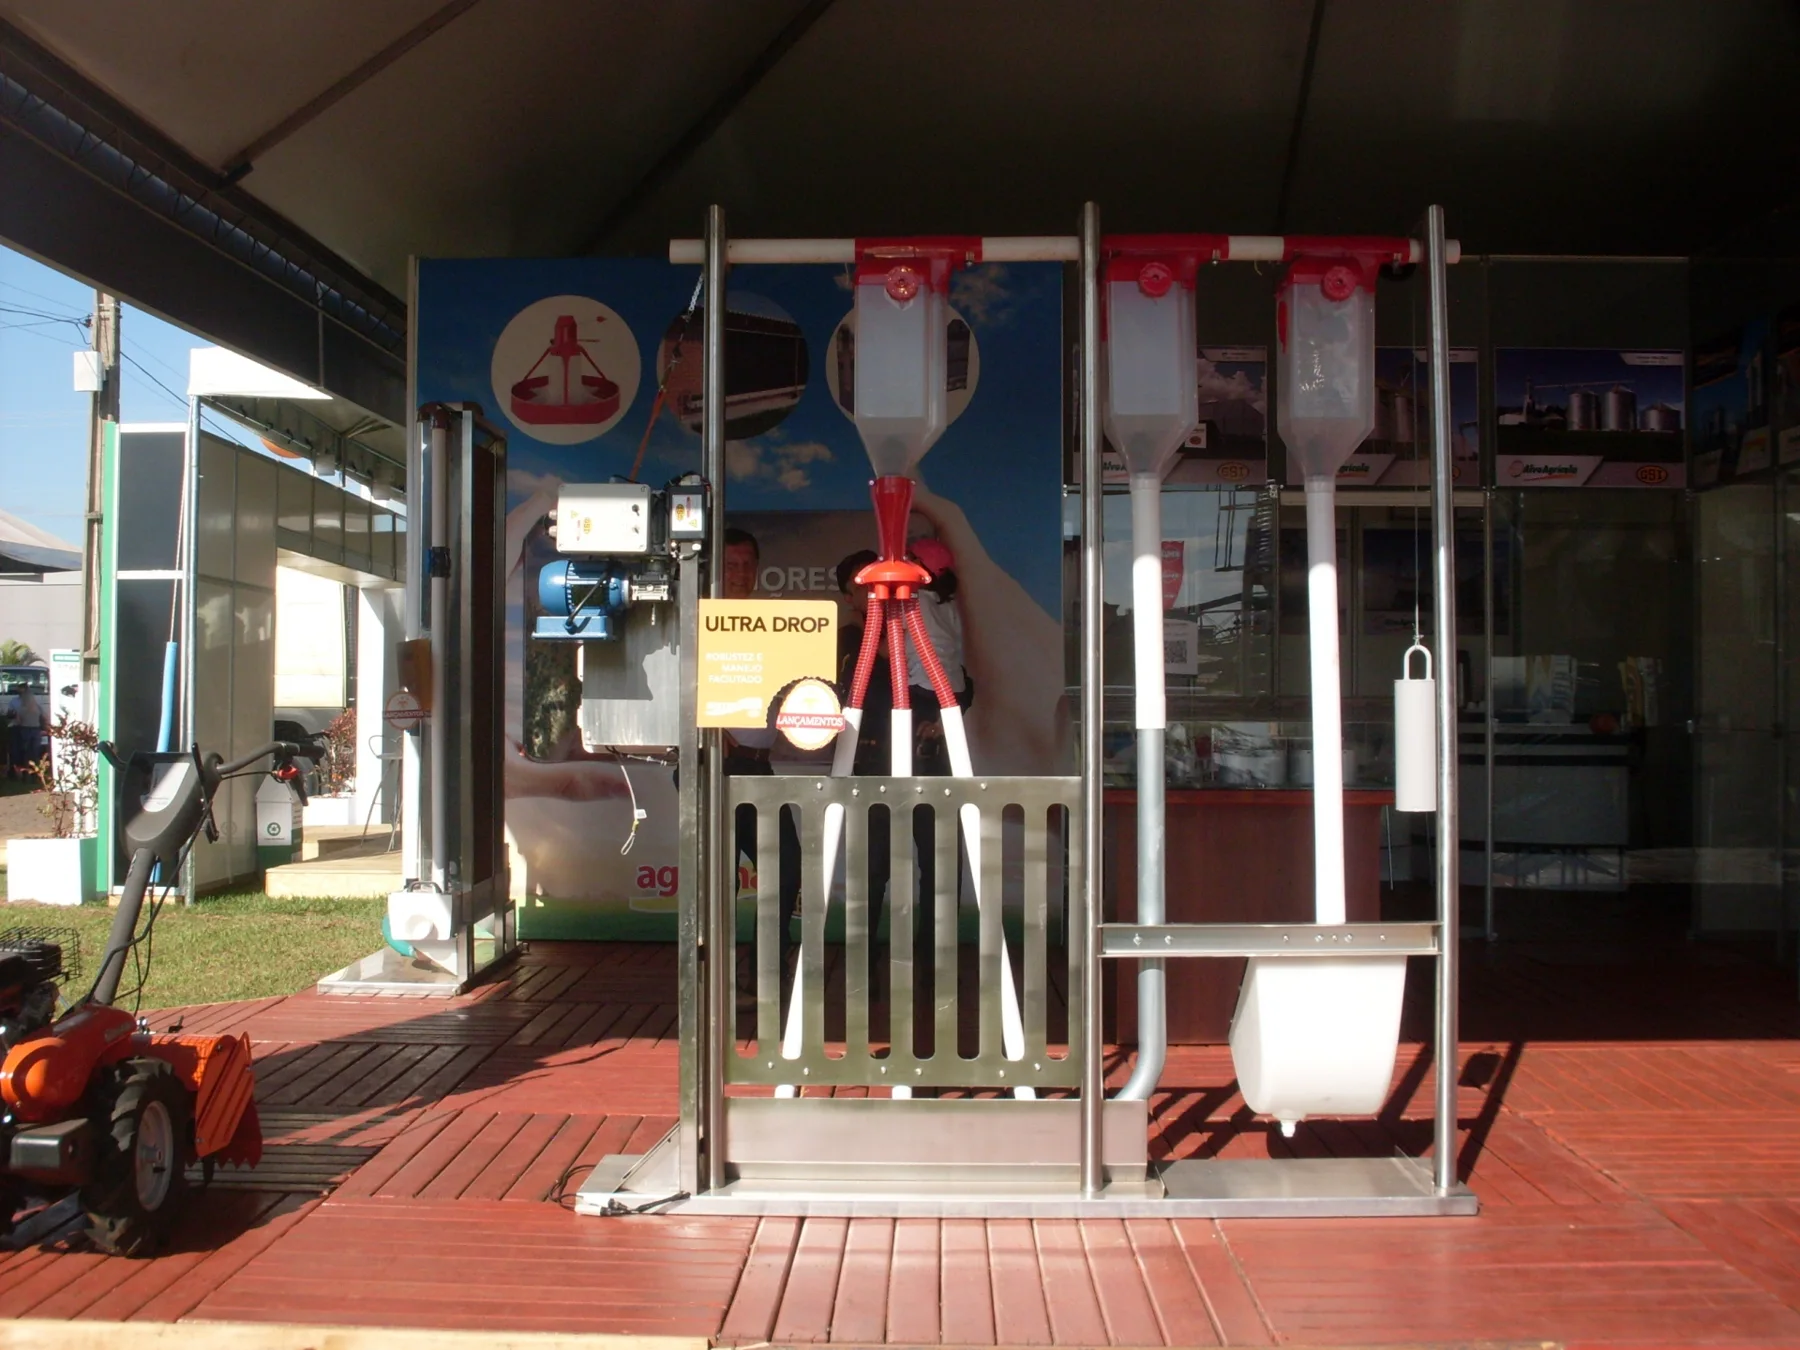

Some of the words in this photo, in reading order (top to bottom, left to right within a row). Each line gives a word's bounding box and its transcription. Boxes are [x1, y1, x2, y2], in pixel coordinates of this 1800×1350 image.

[705, 616, 767, 632] ULTRA
[773, 617, 829, 633] DROP
[776, 714, 844, 727] LANÇAMENTOS
